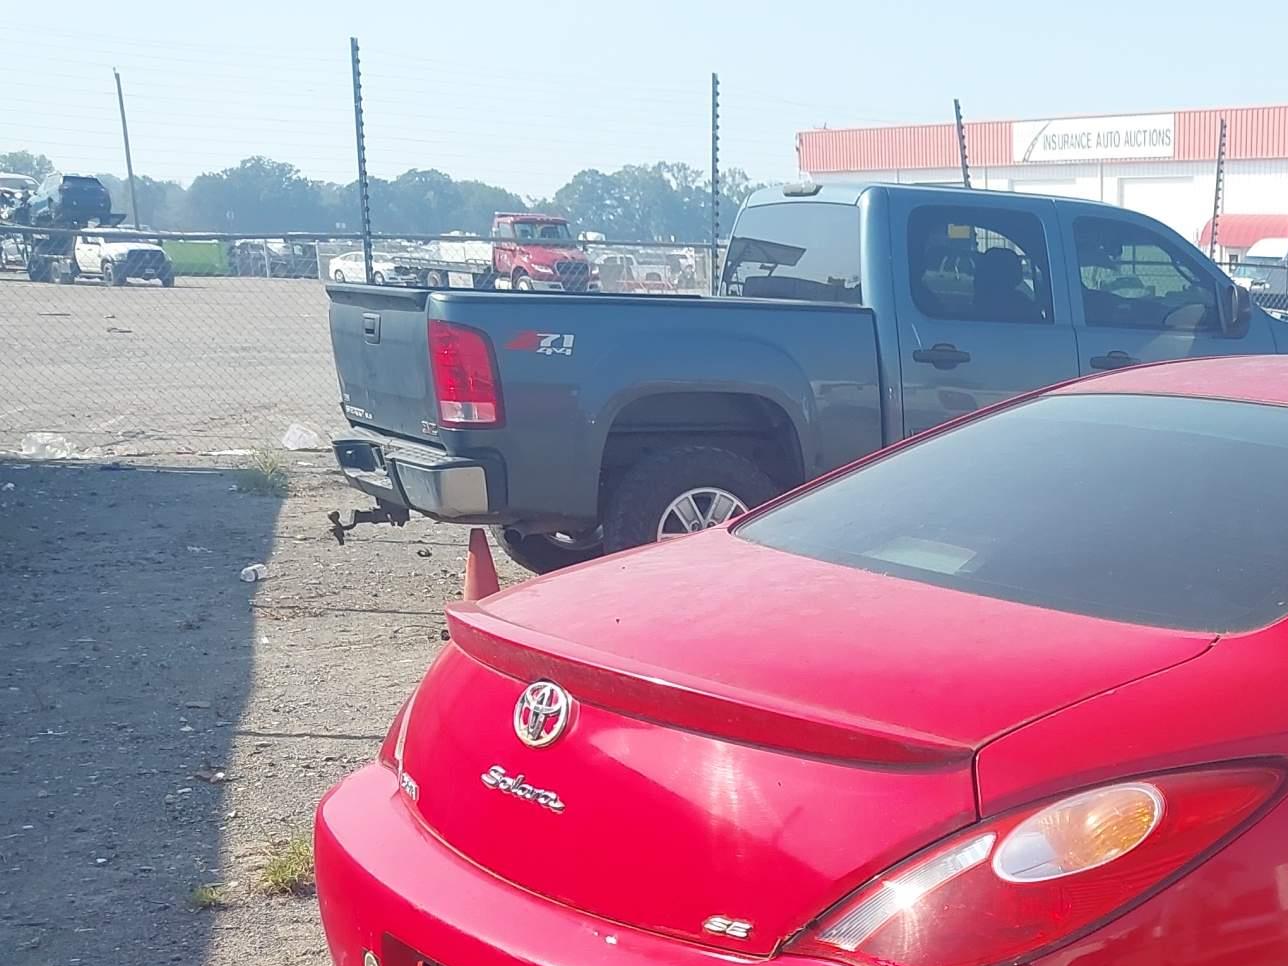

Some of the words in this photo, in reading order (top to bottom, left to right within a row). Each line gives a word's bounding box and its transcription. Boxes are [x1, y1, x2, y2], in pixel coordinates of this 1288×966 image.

[1042, 131, 1092, 150] INSURANCE
[1096, 130, 1121, 149] AUTO
[1124, 127, 1171, 148] AUCTIONS
[480, 765, 565, 812] Solara
[703, 915, 752, 938] SE
